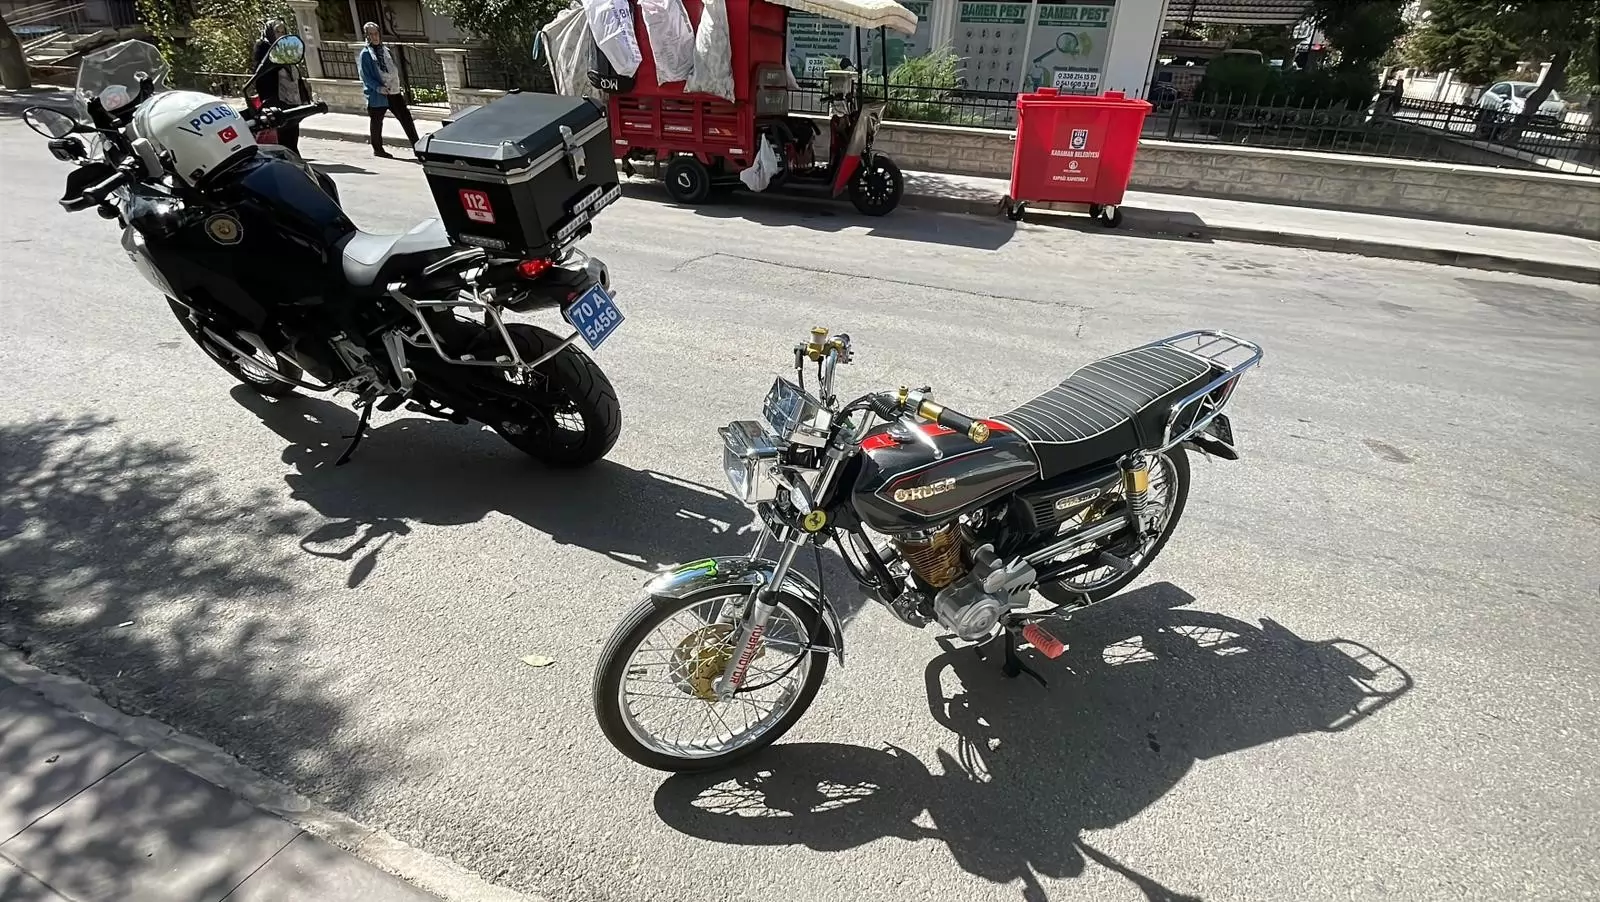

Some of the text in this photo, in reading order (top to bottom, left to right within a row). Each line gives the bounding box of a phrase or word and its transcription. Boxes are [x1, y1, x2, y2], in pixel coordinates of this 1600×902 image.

[961, 3, 1027, 18] BAMER PEST
[1040, 6, 1109, 21] BAMER PEST
[464, 193, 488, 210] 112
[573, 293, 606, 324] 70 A
[585, 306, 617, 341] 5456
